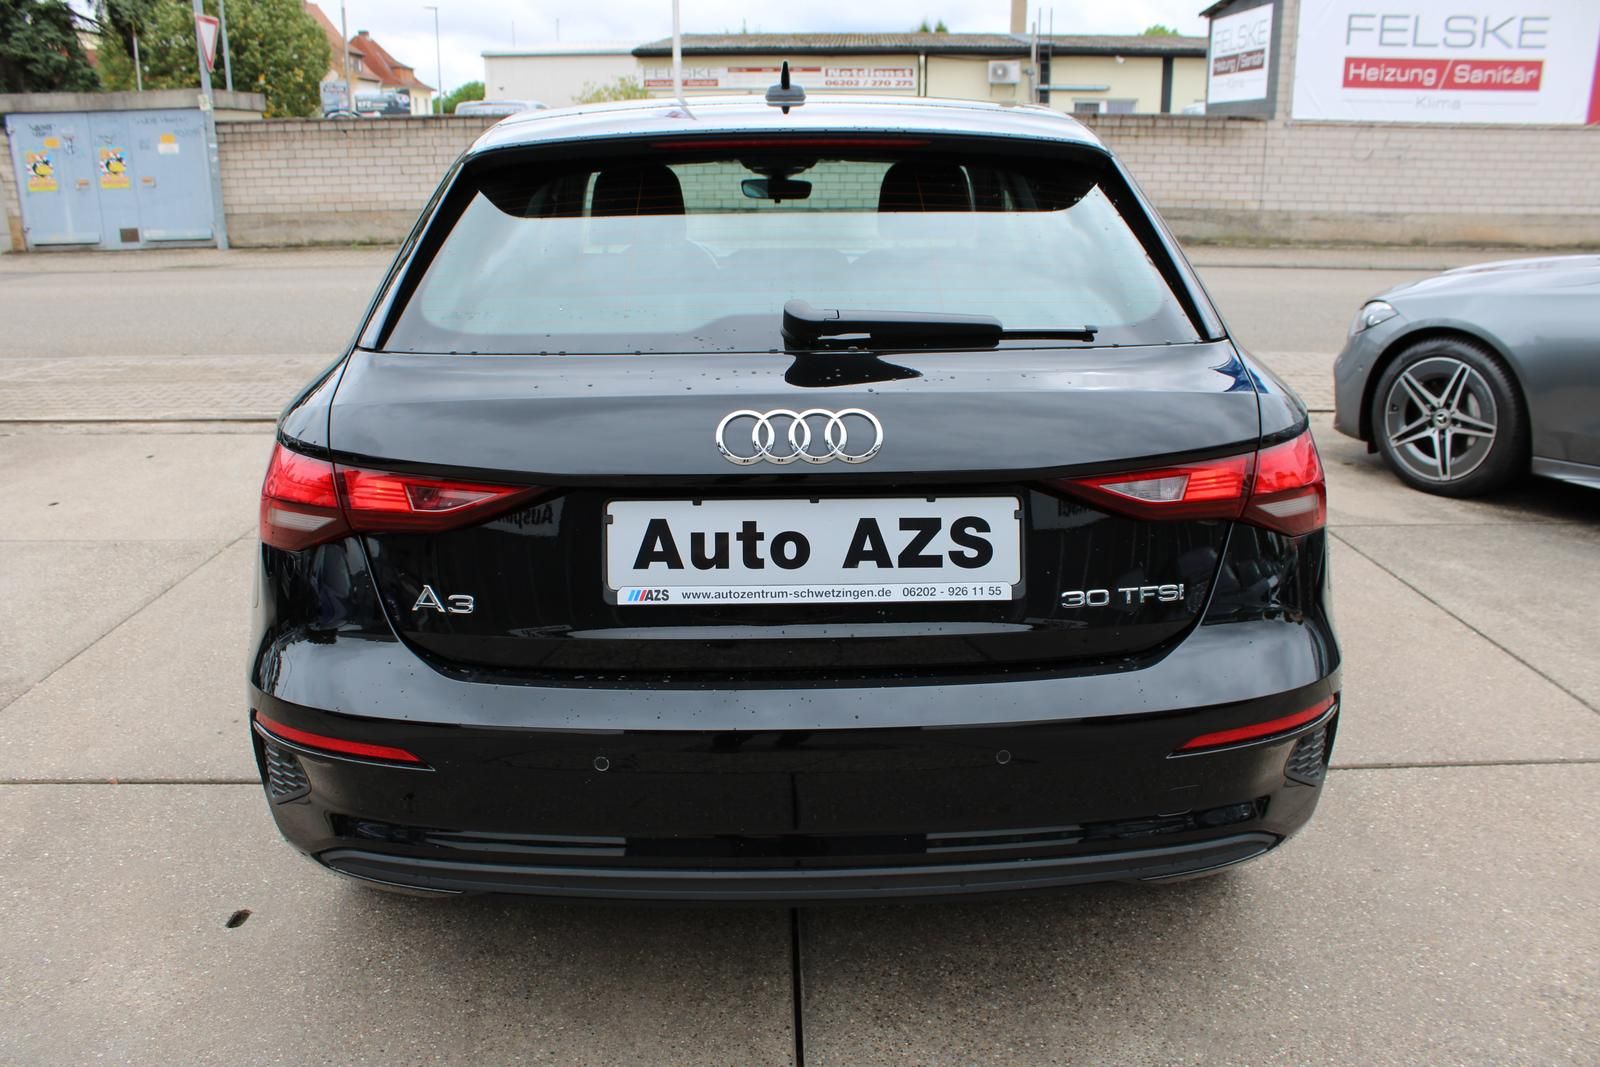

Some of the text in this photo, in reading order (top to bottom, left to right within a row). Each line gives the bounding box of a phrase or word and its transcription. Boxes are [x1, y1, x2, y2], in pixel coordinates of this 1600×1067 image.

[1214, 19, 1267, 53] FELSKE
[1346, 13, 1551, 49] FELSKE
[1348, 63, 1539, 86] Heizung Sanitär
[632, 516, 994, 570] Auto AZS
[412, 584, 474, 614] A3
[644, 589, 670, 601] AZS
[681, 587, 892, 600] www.autozentrum-schwetzingen.de
[902, 587, 936, 597] 06202
[949, 587, 968, 596] 926
[972, 587, 984, 596] 11
[988, 586, 1001, 596] 55
[1061, 583, 1185, 608] 30 TFSI
